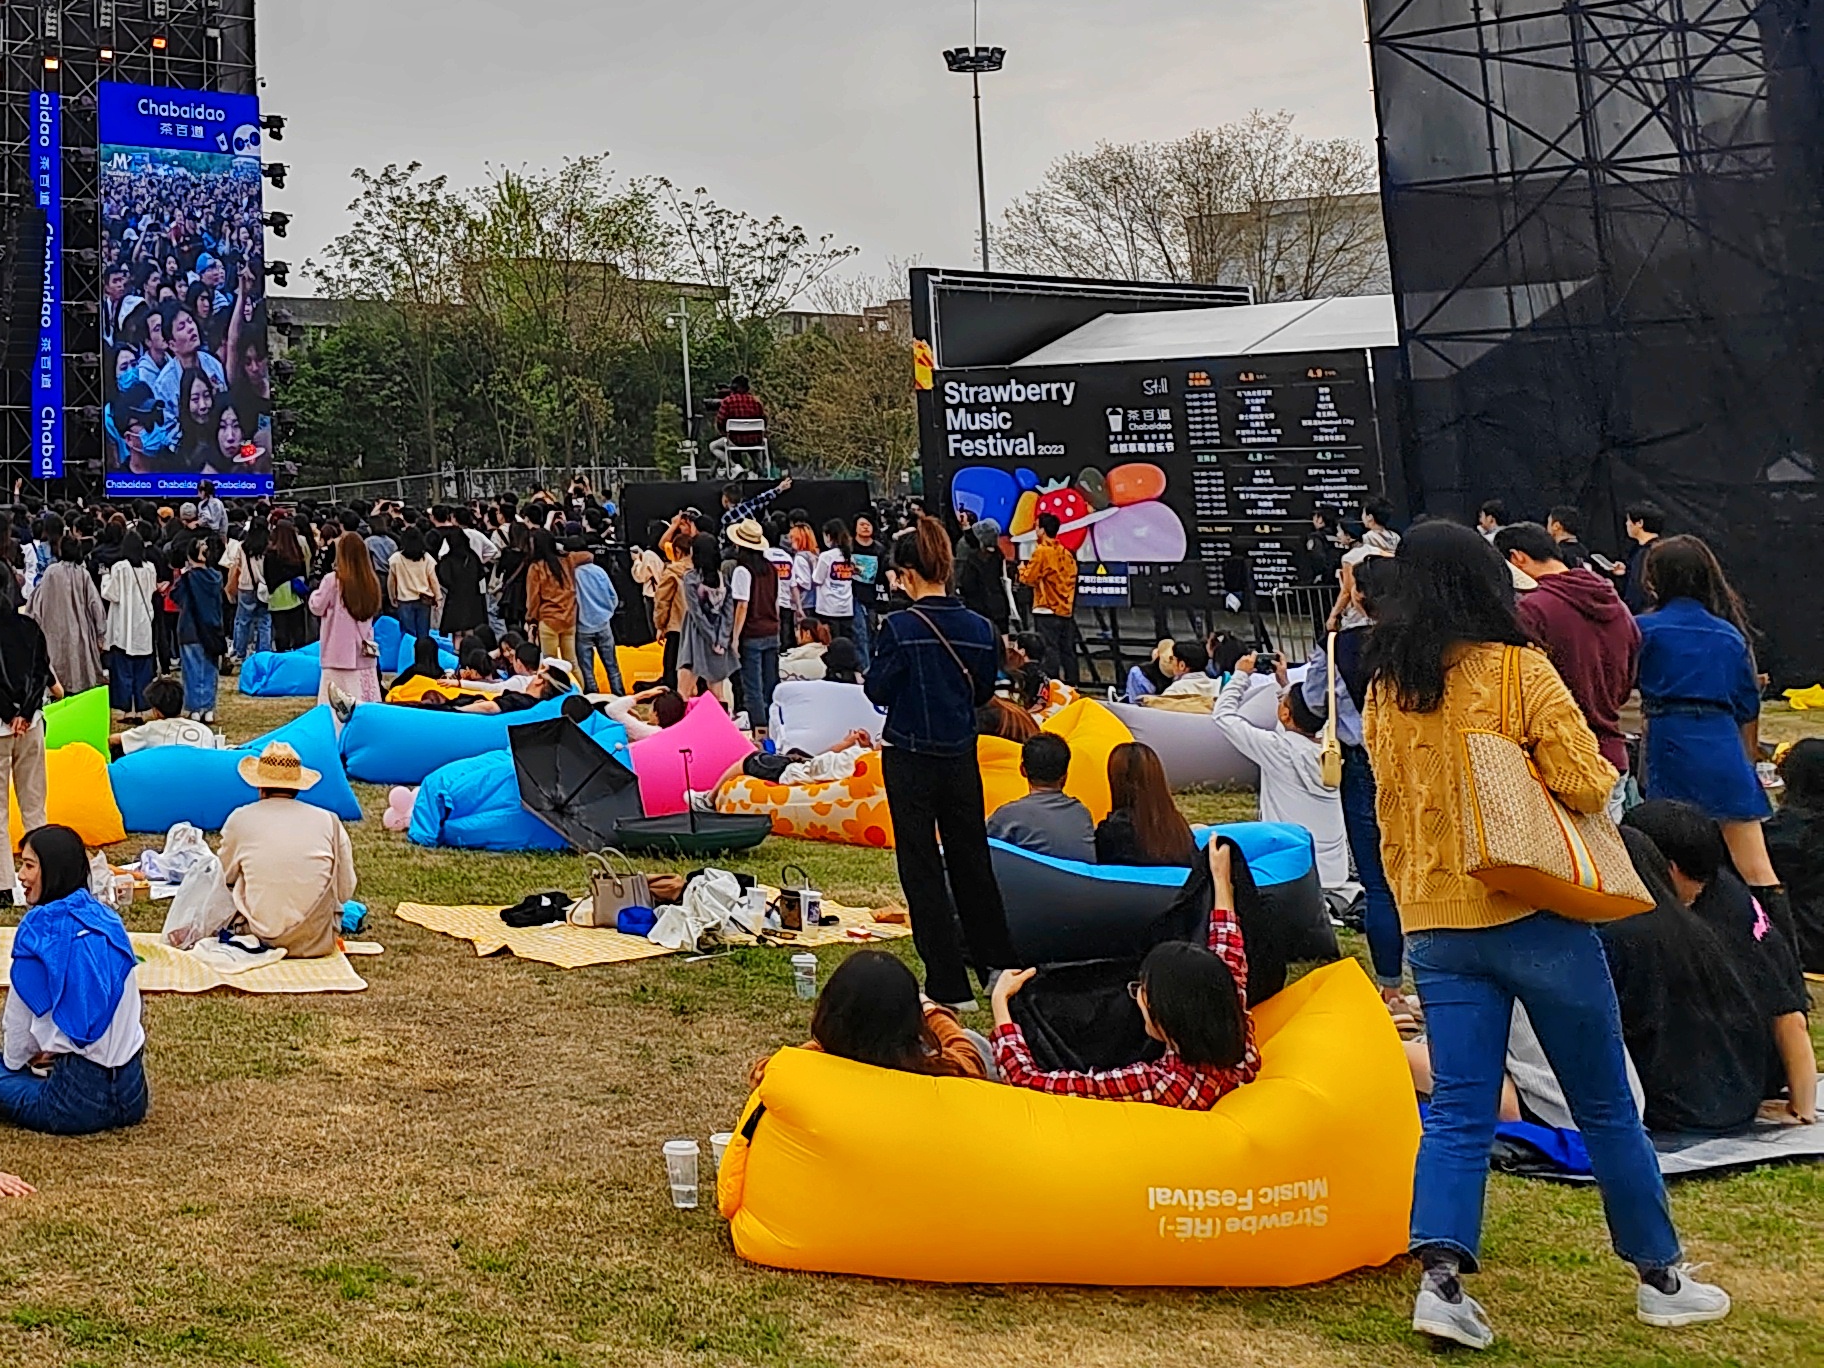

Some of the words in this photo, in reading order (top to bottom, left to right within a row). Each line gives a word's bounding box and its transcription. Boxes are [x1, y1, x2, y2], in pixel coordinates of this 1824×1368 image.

[137, 98, 226, 122] Chabaidao
[159, 123, 205, 139] 茶百道
[944, 379, 1076, 406] Strawberry
[1142, 378, 1169, 395] Still
[945, 406, 1012, 431] Music
[1127, 408, 1172, 421] 茶百道
[41, 406, 56, 478] Chabai
[947, 432, 1036, 457] Festival
[1037, 444, 1065, 455] 2023
[1316, 451, 1332, 461] 4.9
[158, 479, 198, 490] Chabaida
[1147, 1186, 1254, 1212] Festival
[1258, 1176, 1329, 1208] Music
[1226, 1205, 1329, 1236] Strawbe
